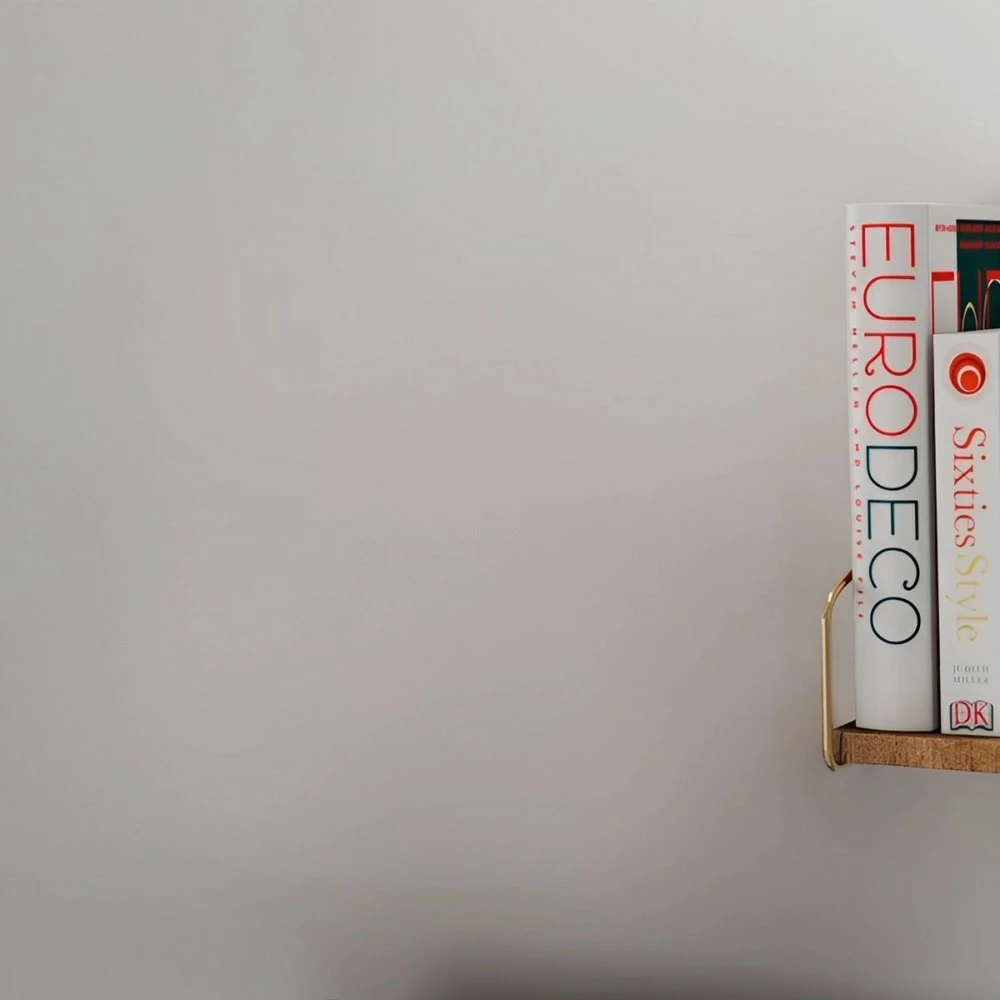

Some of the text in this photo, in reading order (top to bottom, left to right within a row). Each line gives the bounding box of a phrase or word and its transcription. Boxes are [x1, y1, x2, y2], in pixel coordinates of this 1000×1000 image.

[945, 426, 989, 642] Sixties Style
[954, 700, 989, 727] DK
